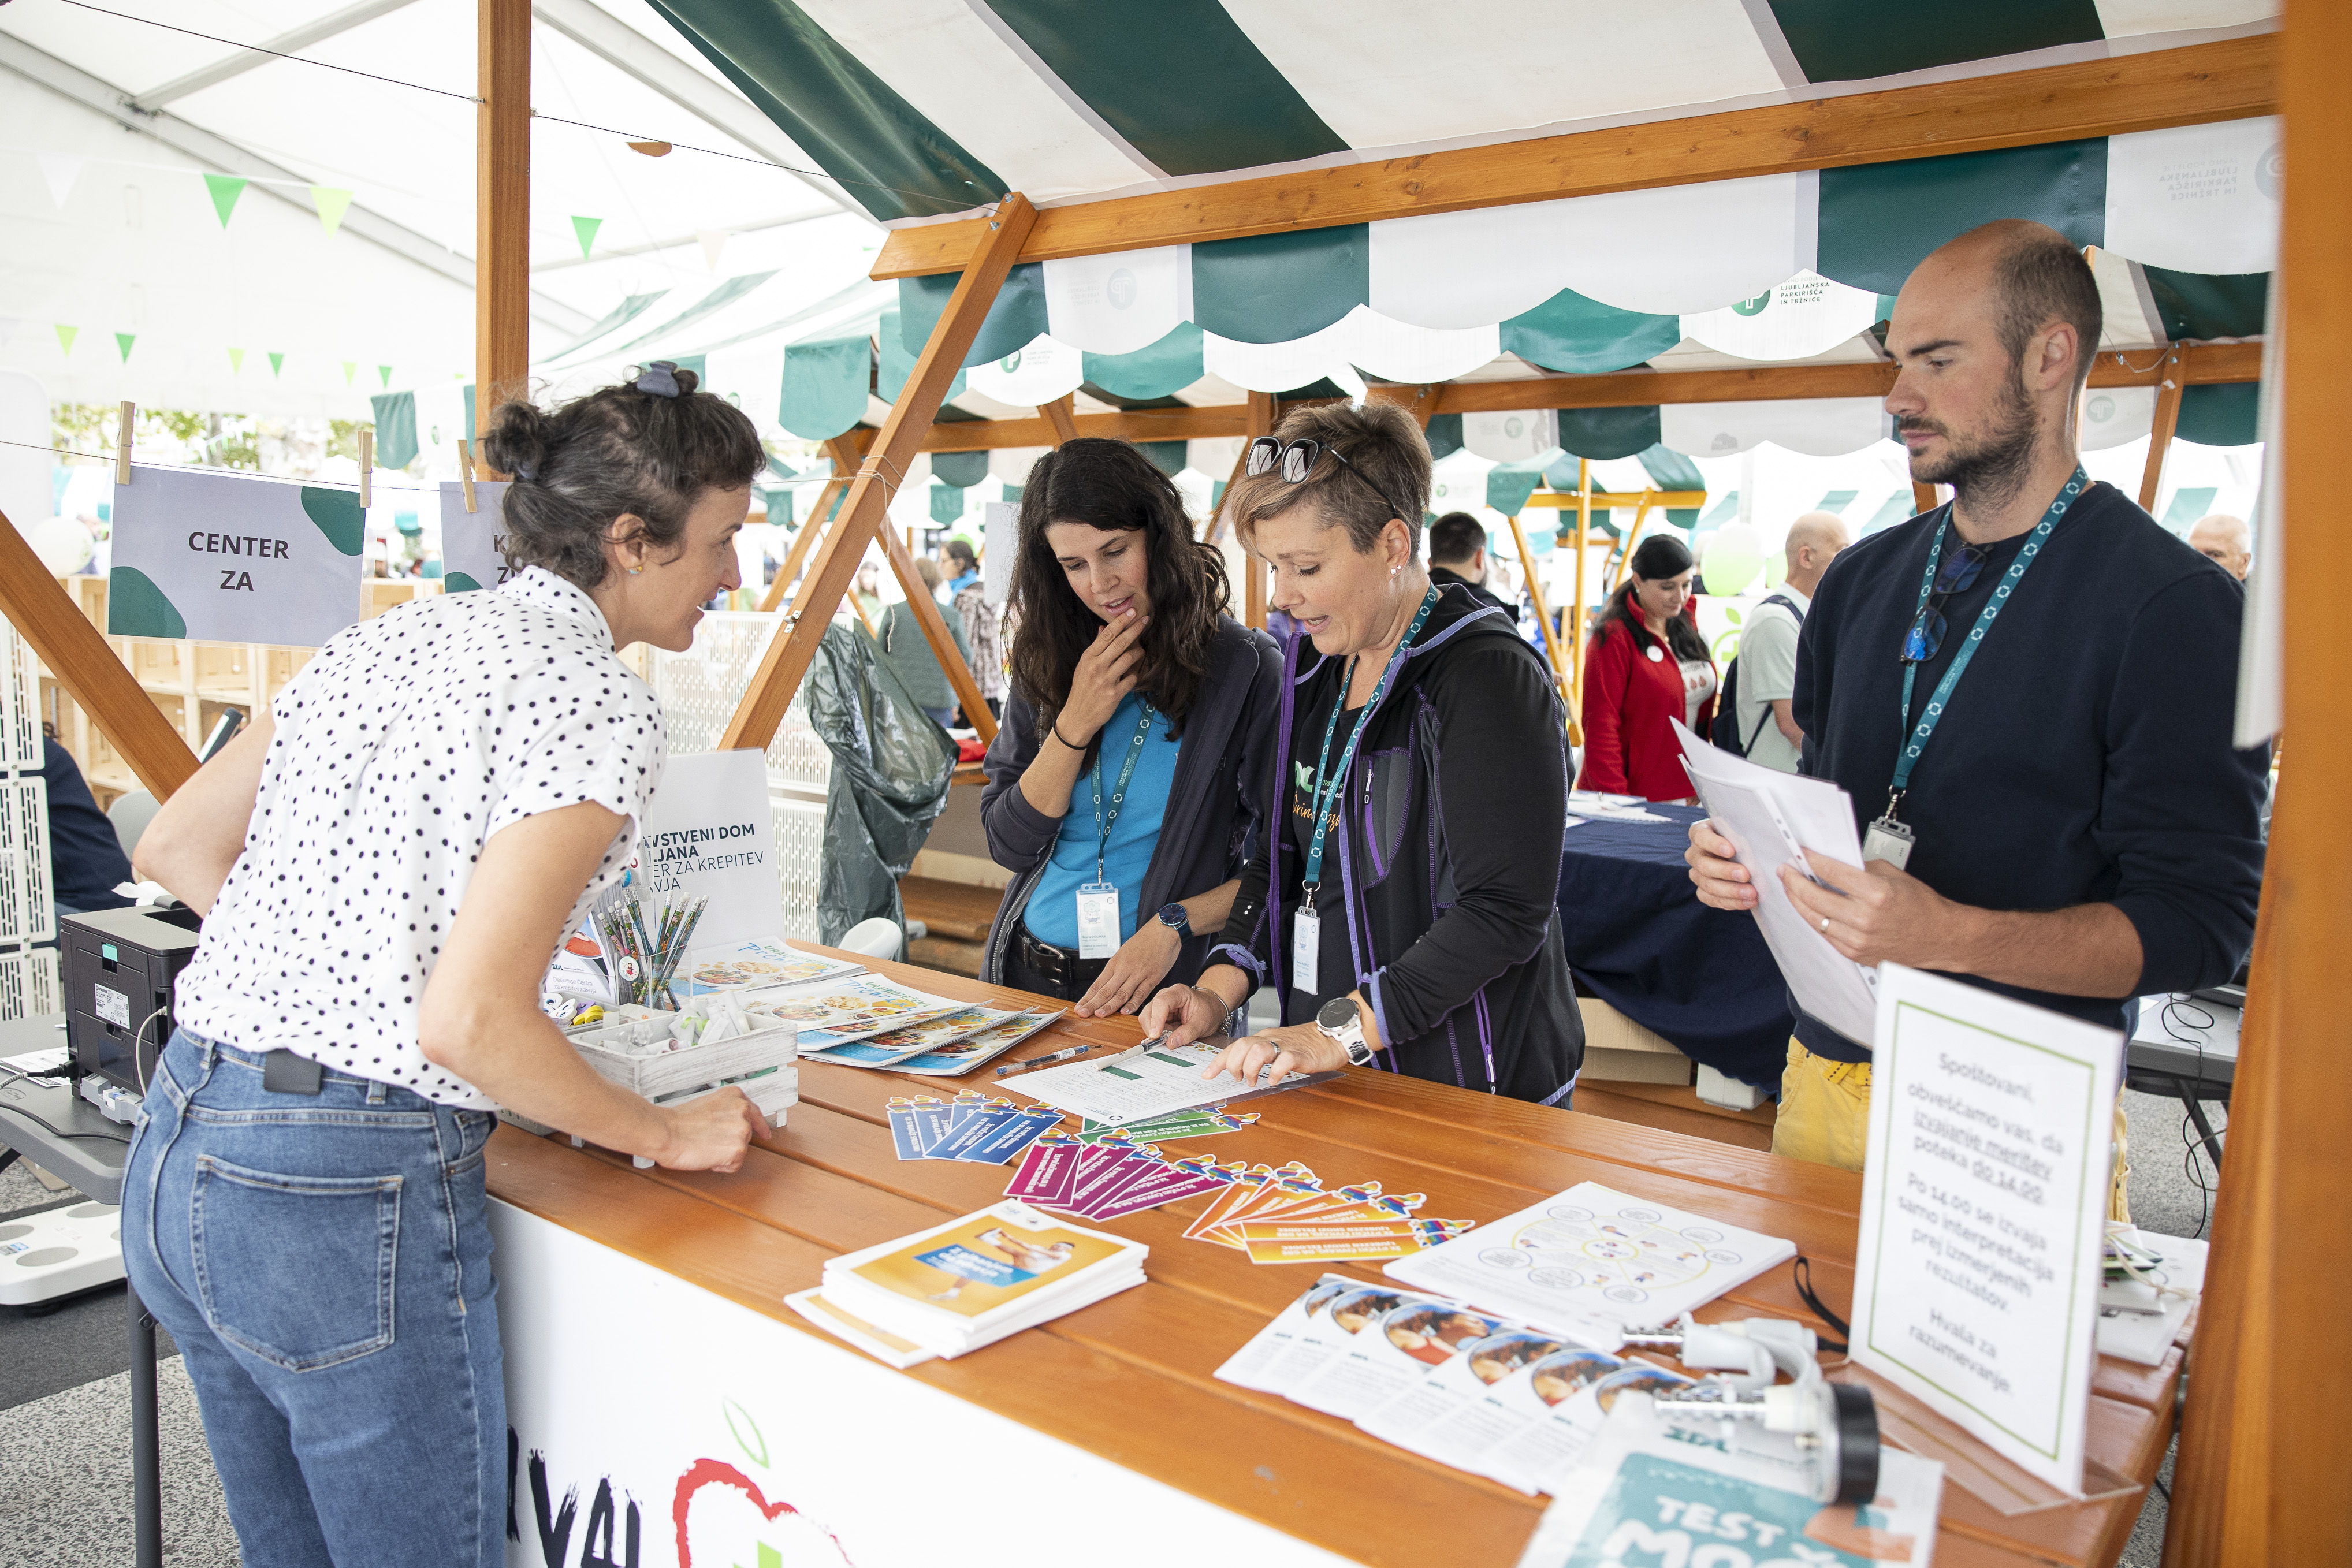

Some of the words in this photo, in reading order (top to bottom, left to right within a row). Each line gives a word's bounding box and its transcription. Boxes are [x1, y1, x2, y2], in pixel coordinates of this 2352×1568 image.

[1781, 282, 1830, 290] LJUBLJANSKA
[1781, 289, 1823, 297] PARKIRIŠČA
[189, 531, 289, 560] CENTER
[220, 570, 254, 591] ZA
[719, 823, 755, 839] DOM
[675, 861, 694, 875] ZA
[698, 851, 764, 872] KREPITEV
[865, 982, 931, 1008] URAVNOTEŽENA
[1914, 1135, 1968, 1168] poteka
[2041, 1135, 2064, 1156] da
[1908, 1172, 1927, 1193] Po
[1977, 1208, 1994, 1225] se
[1999, 1215, 2046, 1250] izvaja
[1899, 1195, 1938, 1224] samo
[1942, 1214, 2053, 1282] interpretacija
[1912, 1228, 1943, 1256] prej
[1946, 1242, 2031, 1297] izmerjenih
[1930, 1308, 1975, 1346] Hvala
[1979, 1339, 1997, 1360] za
[1657, 1495, 1785, 1548] TEST
